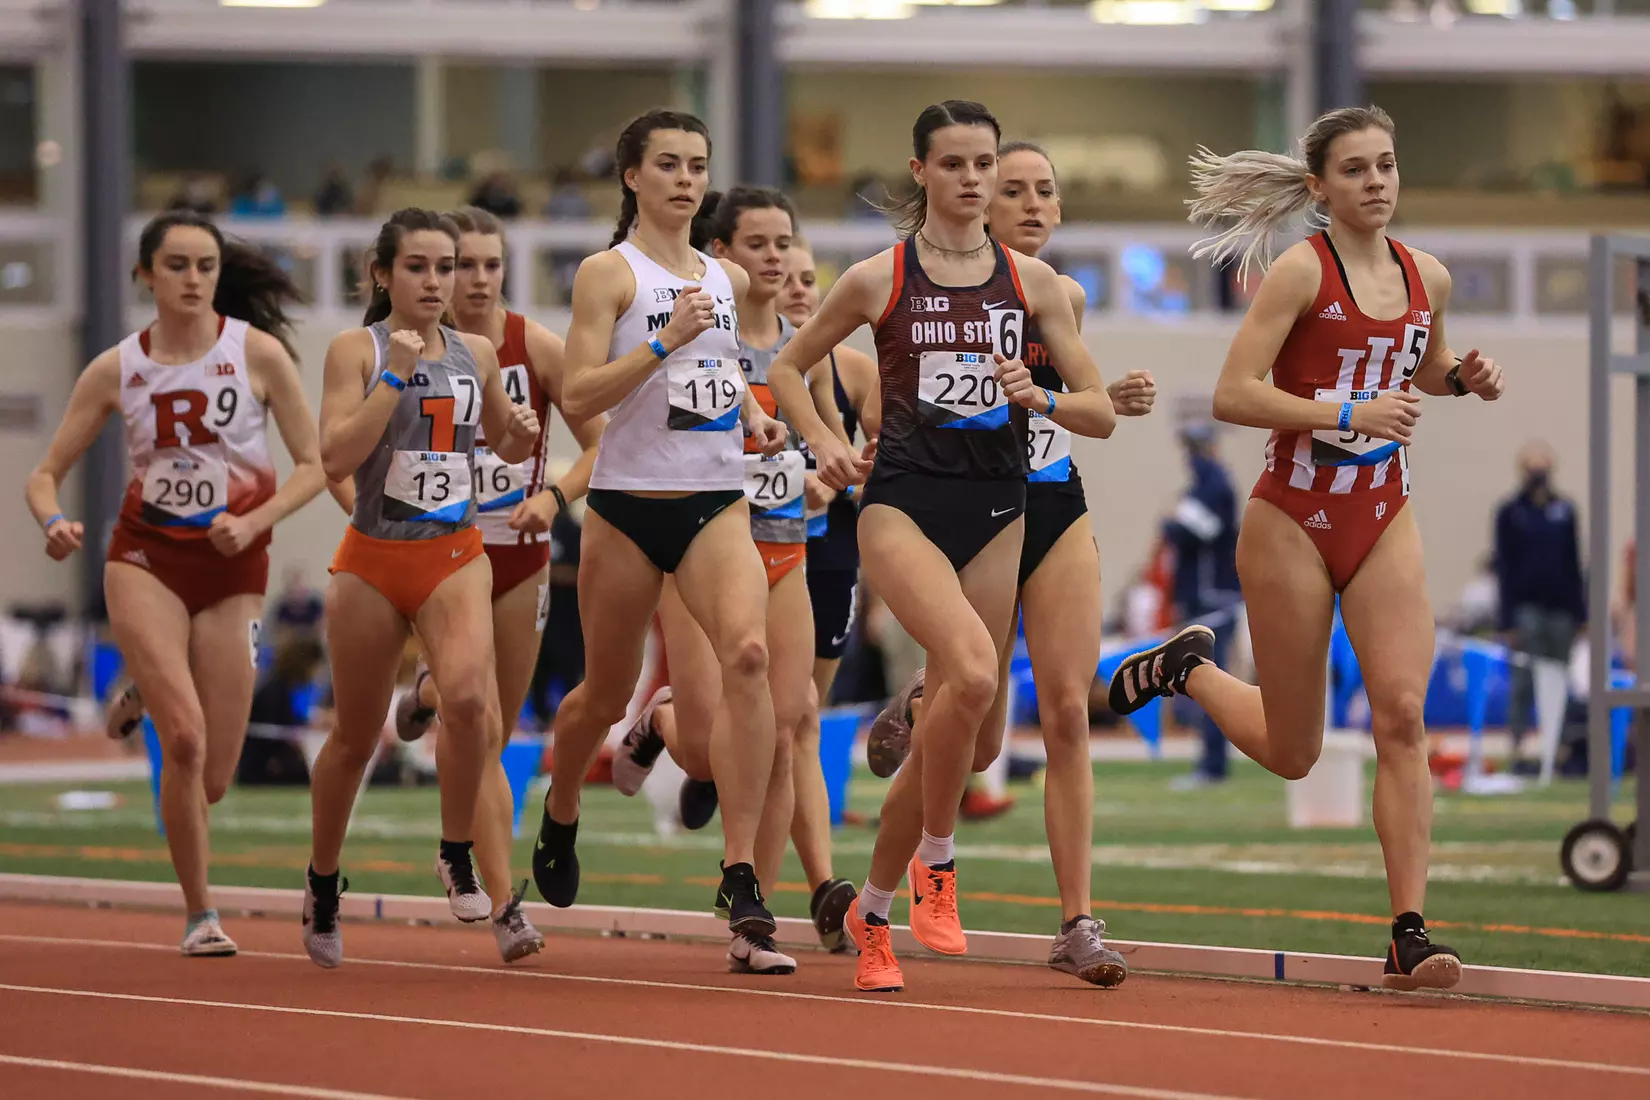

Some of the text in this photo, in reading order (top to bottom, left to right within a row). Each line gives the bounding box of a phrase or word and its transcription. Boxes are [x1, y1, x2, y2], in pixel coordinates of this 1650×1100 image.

[911, 321, 993, 344] OHIO STA
[1319, 312, 1347, 321] adidas
[1000, 312, 1018, 360] 6
[1402, 329, 1427, 378] 5
[457, 378, 475, 423] 7
[505, 369, 525, 405] 4
[685, 379, 737, 409] 119
[934, 373, 998, 408] 220
[150, 389, 219, 450] R
[213, 386, 238, 428] 9
[154, 478, 215, 507] 290
[412, 471, 451, 501] 13
[752, 471, 788, 500] 20
[1303, 521, 1332, 530] adidas
